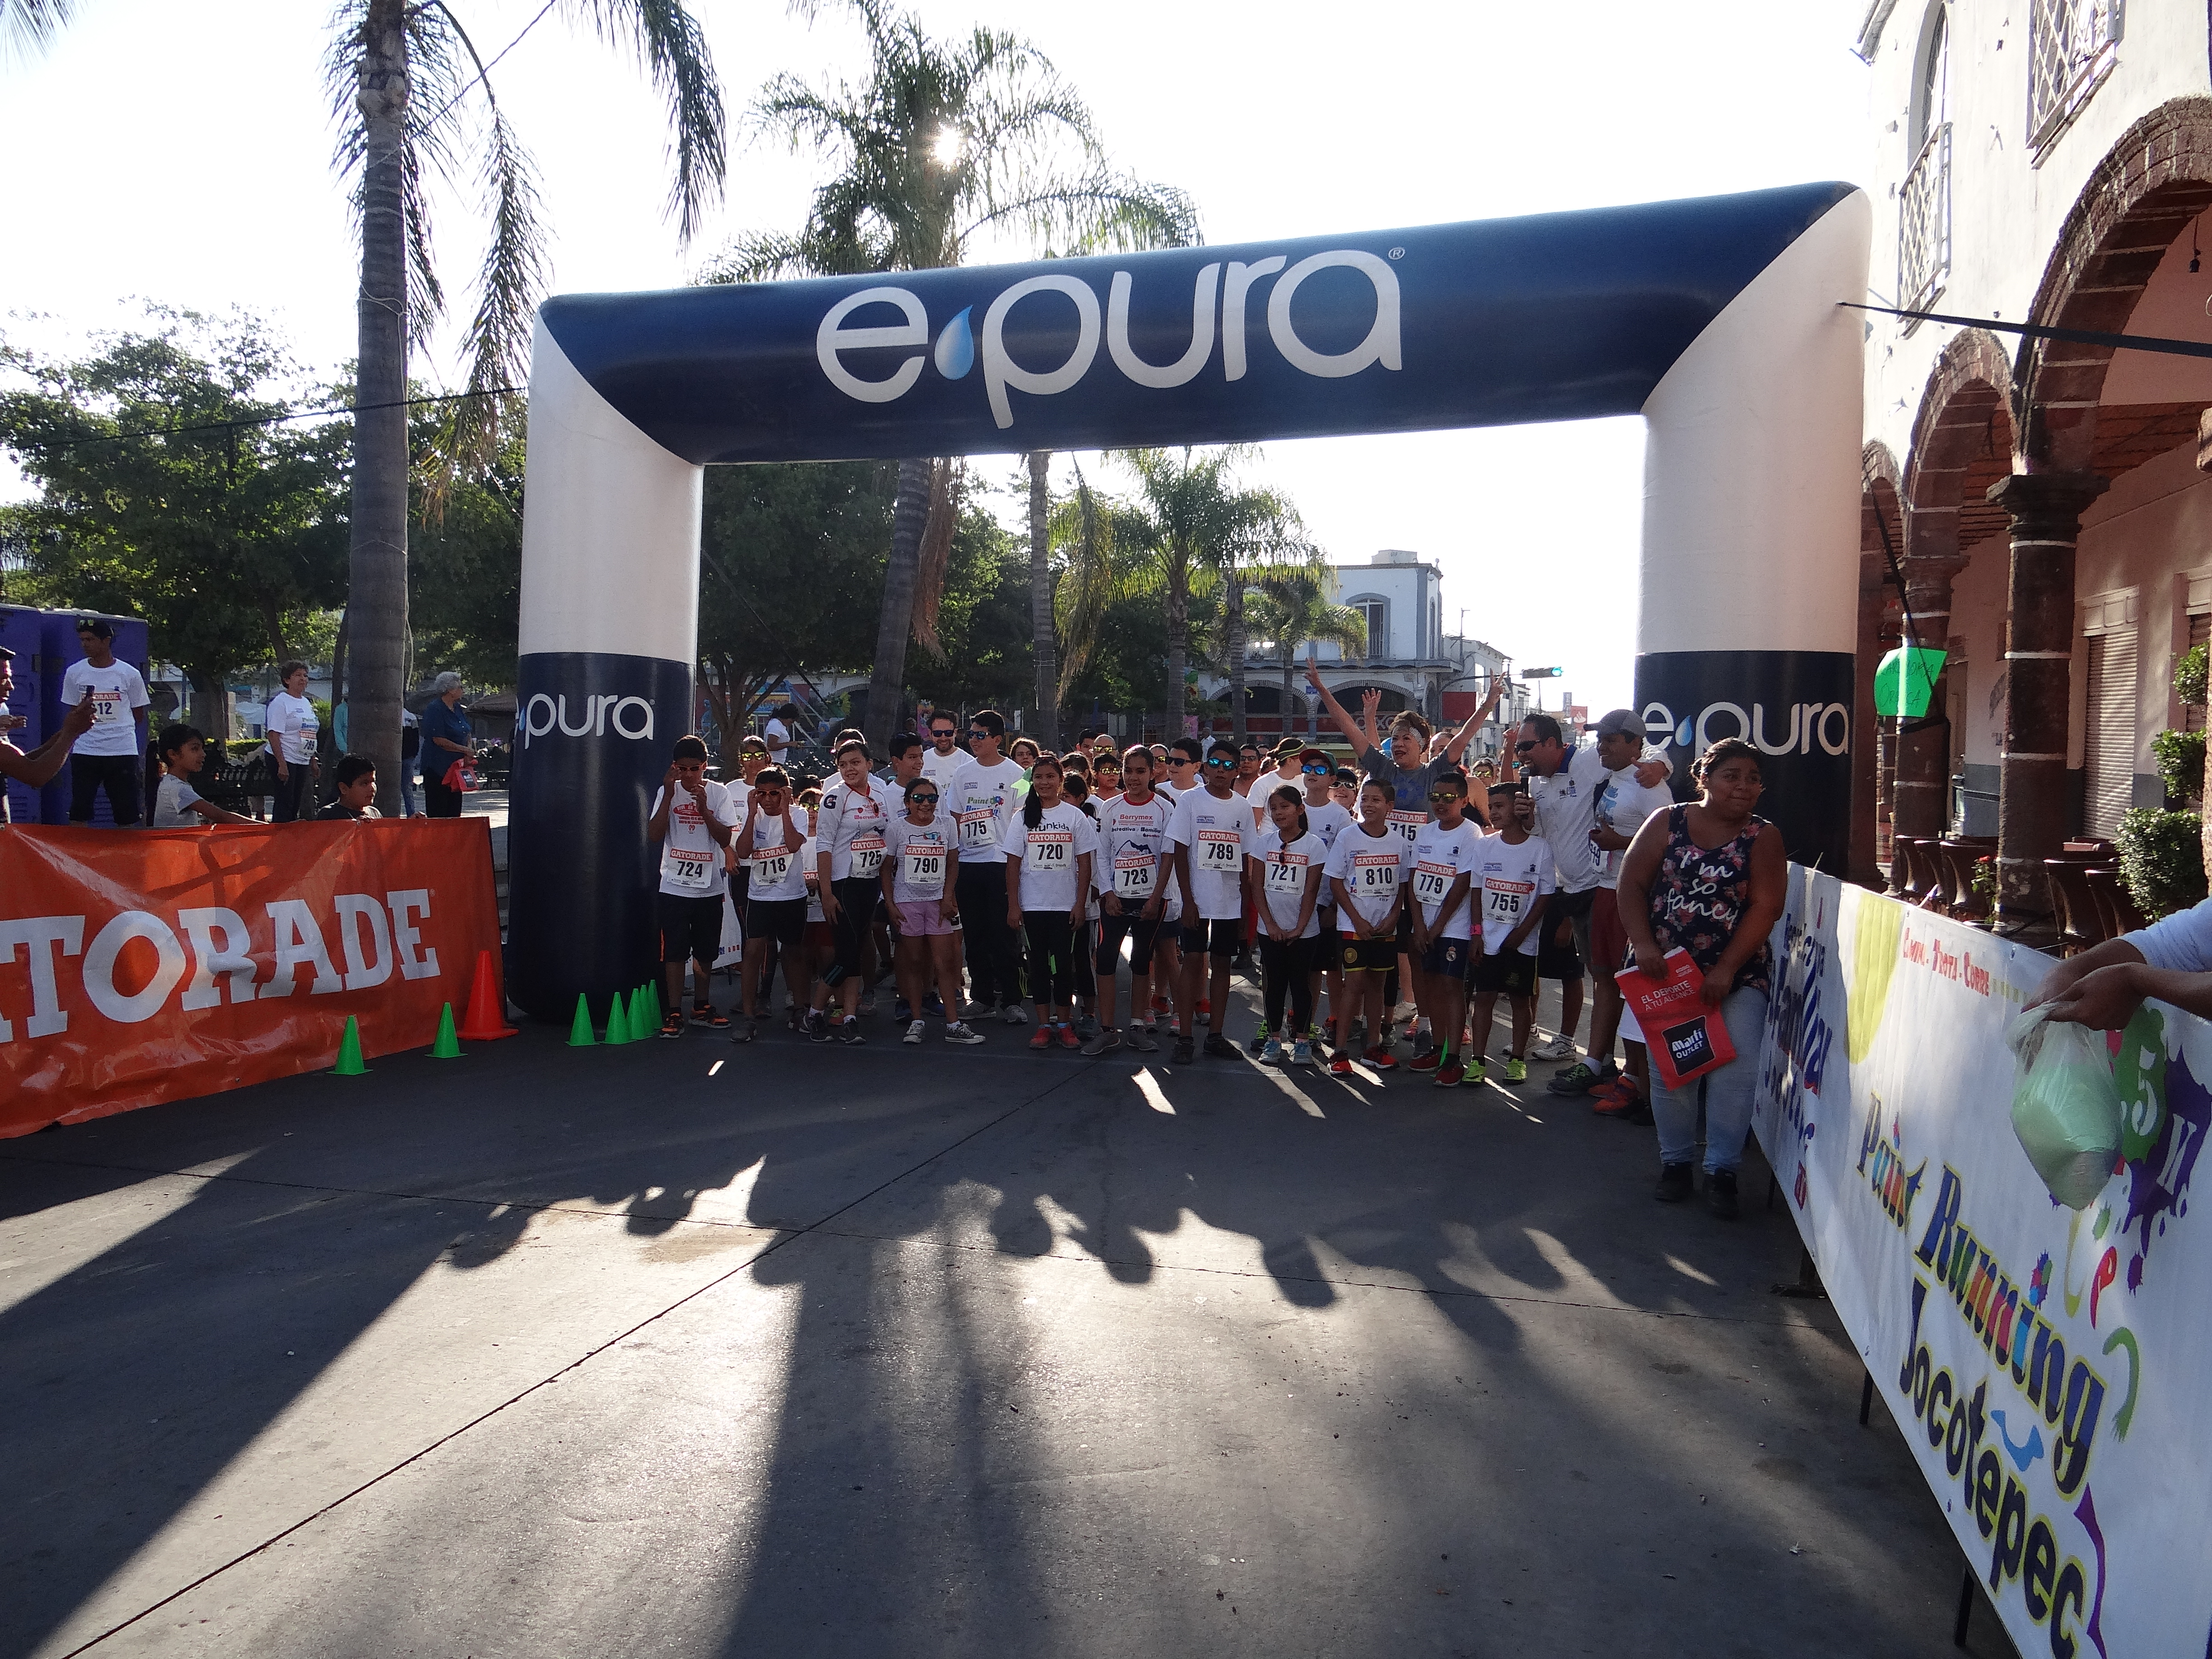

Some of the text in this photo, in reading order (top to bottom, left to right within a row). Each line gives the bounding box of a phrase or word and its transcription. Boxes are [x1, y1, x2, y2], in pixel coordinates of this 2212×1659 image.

[816, 249, 1402, 429] epura
[91, 702, 112, 714] 12
[515, 694, 653, 750] pura
[965, 821, 987, 838] 775
[1200, 832, 1238, 842] GATORADE
[1390, 823, 1417, 841] 715
[671, 850, 711, 860] GATORADE
[754, 847, 788, 858] GATORAD
[860, 850, 881, 867] 725
[1037, 844, 1063, 860] 720
[1208, 843, 1233, 860] 789
[1356, 856, 1397, 864] GATORADE
[677, 861, 703, 877] 724
[759, 858, 786, 876] 718
[913, 858, 938, 873] 790
[1115, 858, 1153, 867] GATORADE
[1418, 862, 1453, 875] GATORADE
[1680, 851, 1734, 878] I'm
[1123, 868, 1148, 886] 723
[1271, 864, 1297, 882] 721
[1366, 867, 1392, 885] 810
[1419, 874, 1443, 894] 779
[1486, 880, 1527, 892] GATORADE
[1688, 878, 1717, 895] so
[1491, 892, 1520, 912] 755
[1664, 888, 1739, 930] fancy
[0, 889, 441, 1042] TORADE
[1641, 980, 1691, 1004] EL DEPORTE
[1651, 999, 1662, 1007] TU
[1664, 988, 1696, 1003] ALCANCE
[1676, 1040, 1702, 1059] OUTLET
[1857, 1090, 1927, 1229] Paint
[1914, 1161, 2107, 1499] Running
[1898, 1275, 2084, 1659] Jocotepec
